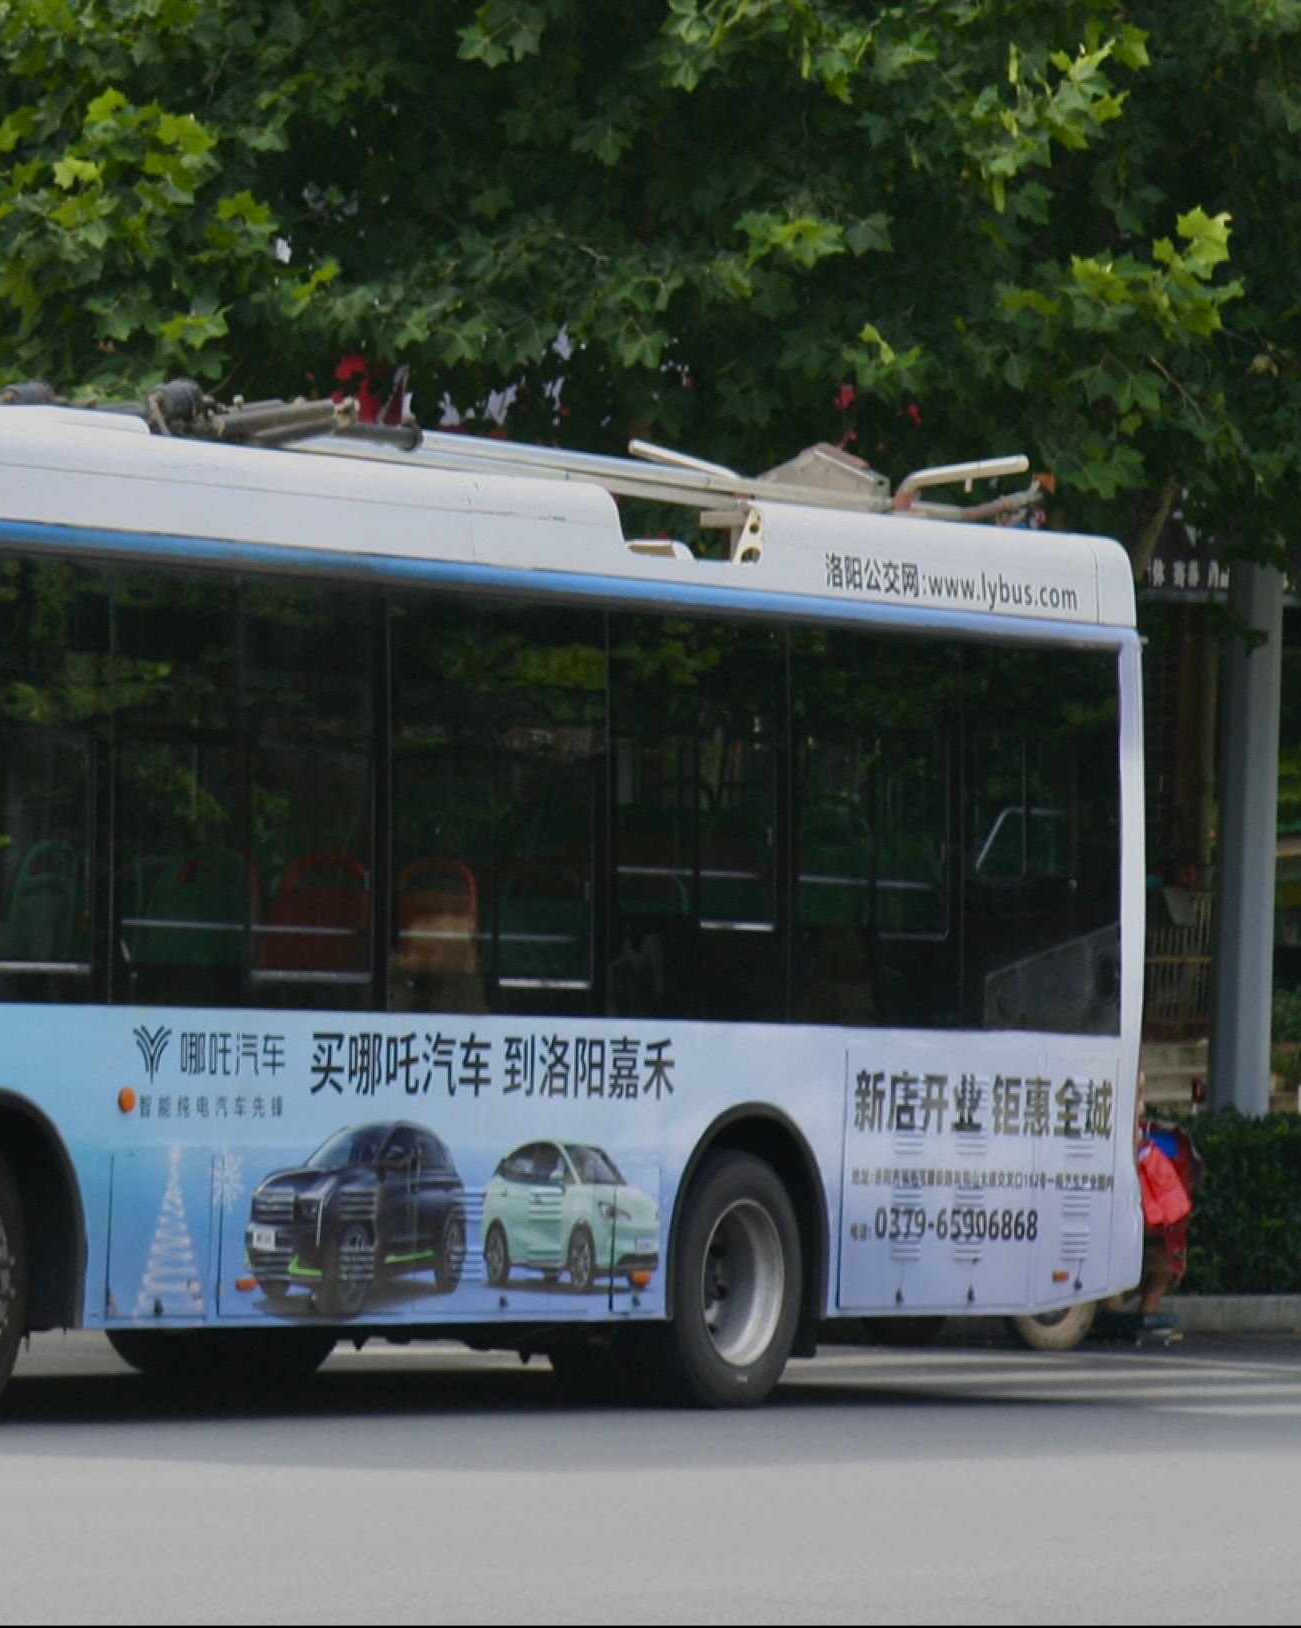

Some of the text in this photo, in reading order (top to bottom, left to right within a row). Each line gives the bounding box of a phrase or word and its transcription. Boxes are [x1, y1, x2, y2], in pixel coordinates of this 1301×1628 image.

[180, 1031, 287, 1077] 哪吒汽车
[310, 1031, 675, 1100] 买哪吒汽车 到洛阳嘉禾
[139, 1094, 284, 1118] 智能纯电汽车先锋
